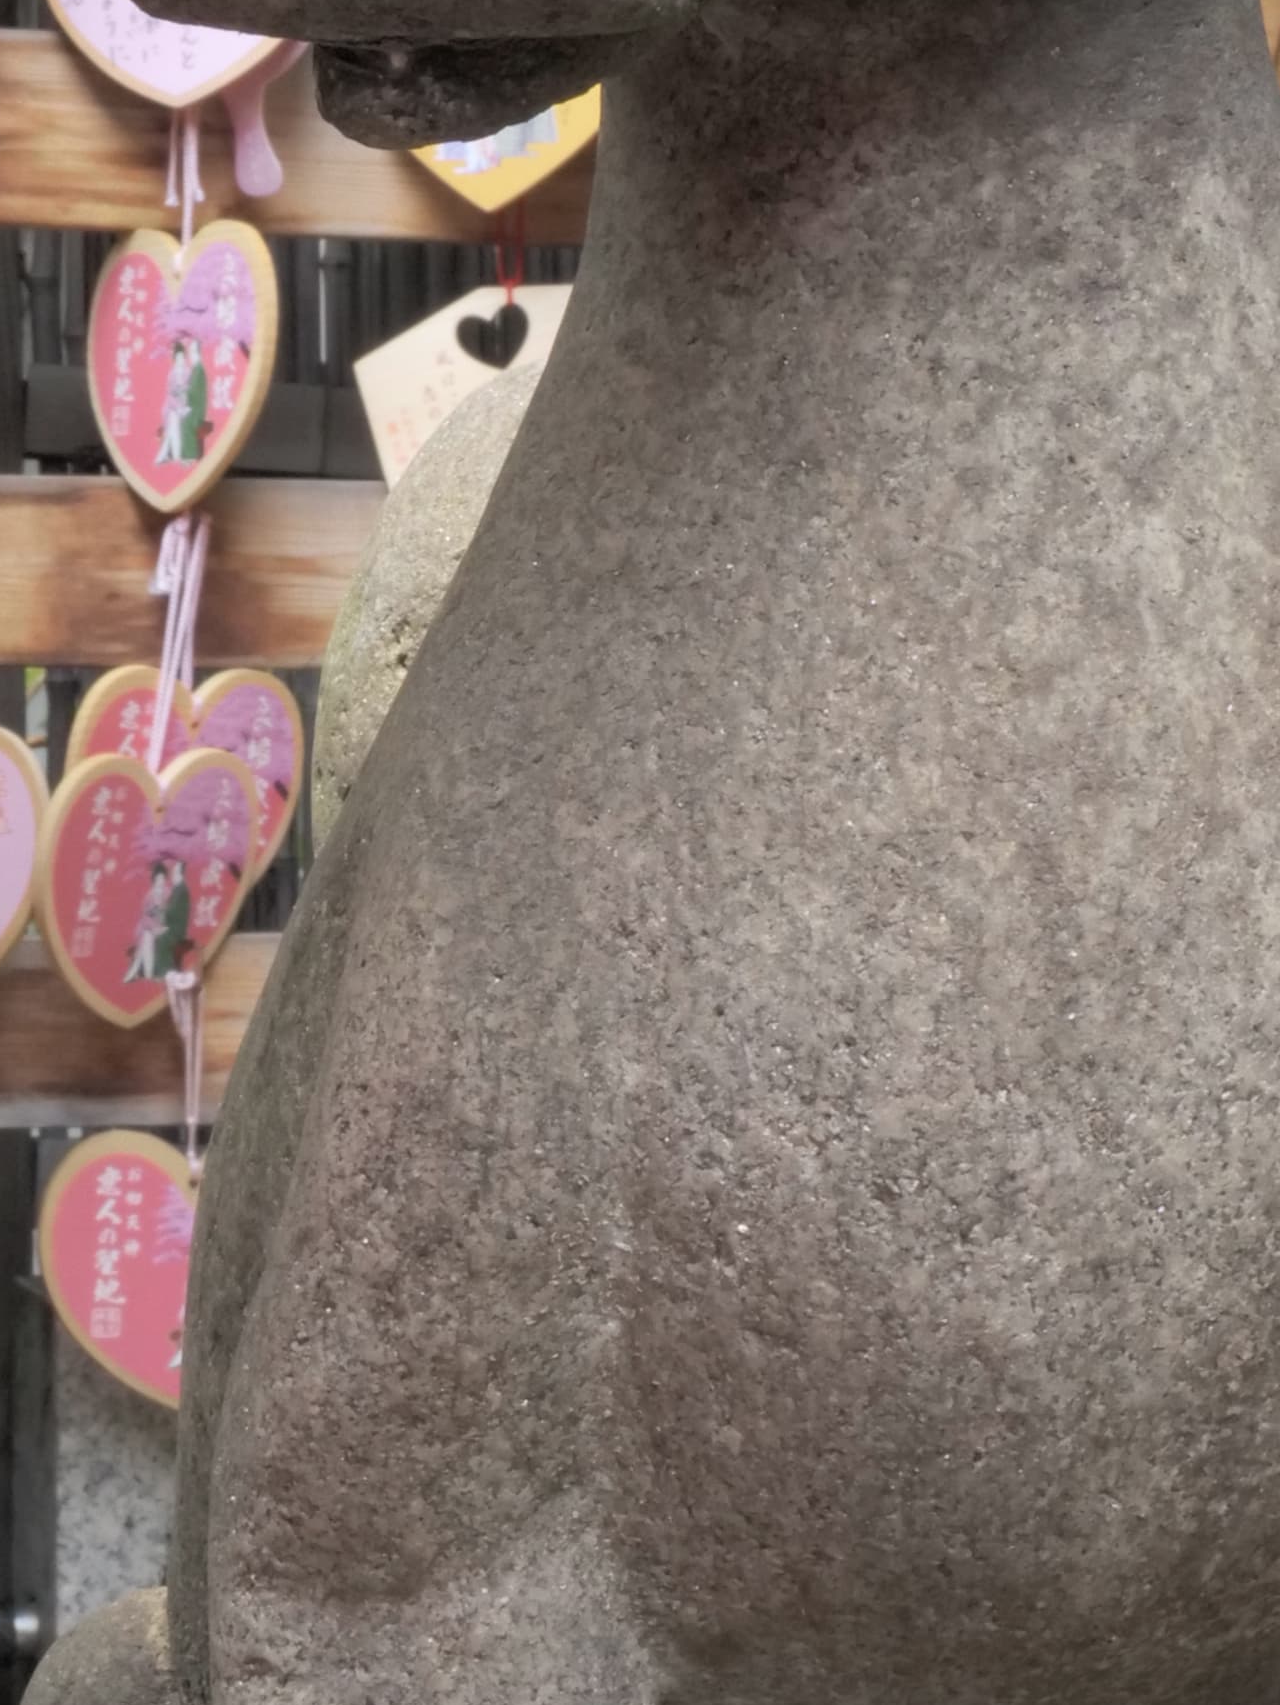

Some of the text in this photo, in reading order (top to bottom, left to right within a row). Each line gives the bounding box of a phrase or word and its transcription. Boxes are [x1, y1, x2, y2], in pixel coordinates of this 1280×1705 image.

[93, 1165, 127, 1305] 恋人の聖地
